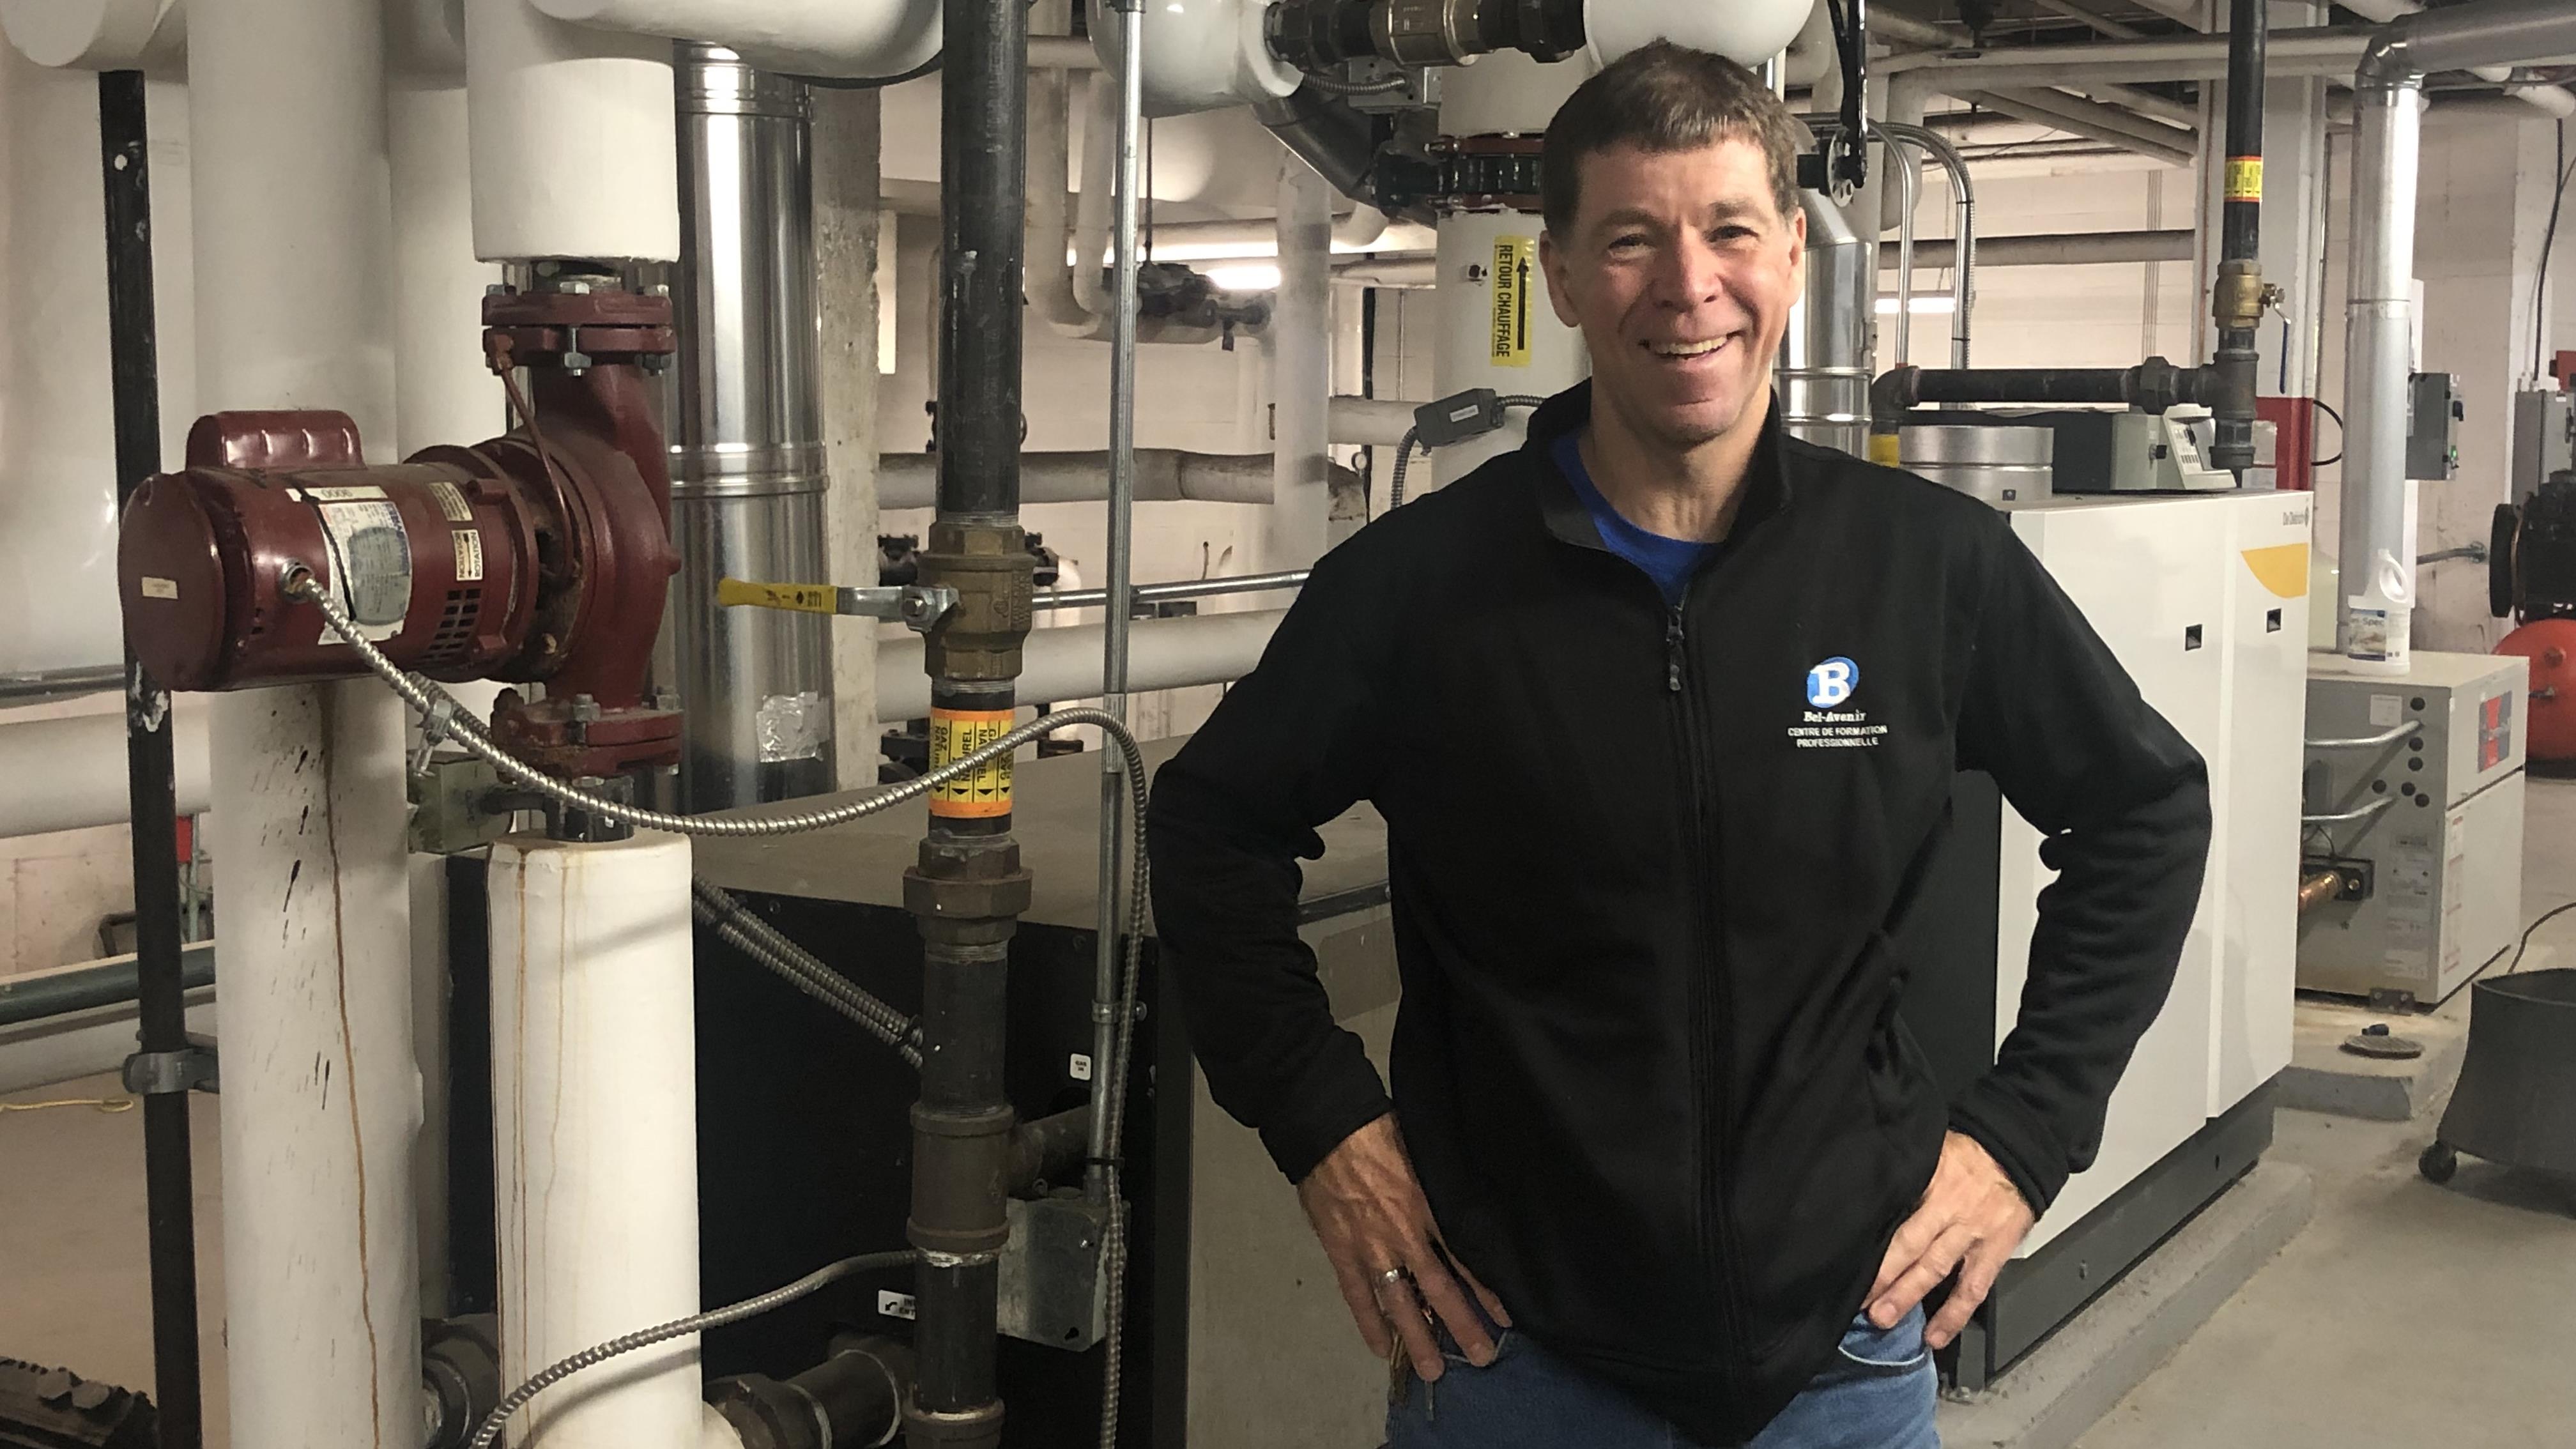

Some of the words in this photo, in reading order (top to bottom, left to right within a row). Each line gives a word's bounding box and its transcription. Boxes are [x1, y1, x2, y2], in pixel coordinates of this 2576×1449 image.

[1498, 245, 1513, 289] RETOUR
[1496, 292, 1512, 357] CHAUFFAGE
[455, 532, 465, 578] ROTATION
[470, 532, 480, 577] ROTATION
[1810, 662, 1851, 704] B
[1788, 727, 1821, 736] CENTRE
[1821, 727, 1834, 736] DE
[1835, 725, 1888, 735] FORMATION
[1804, 709, 1866, 722] Bel-Avenir
[1797, 737, 1880, 747] PROFESSIONNELLE
